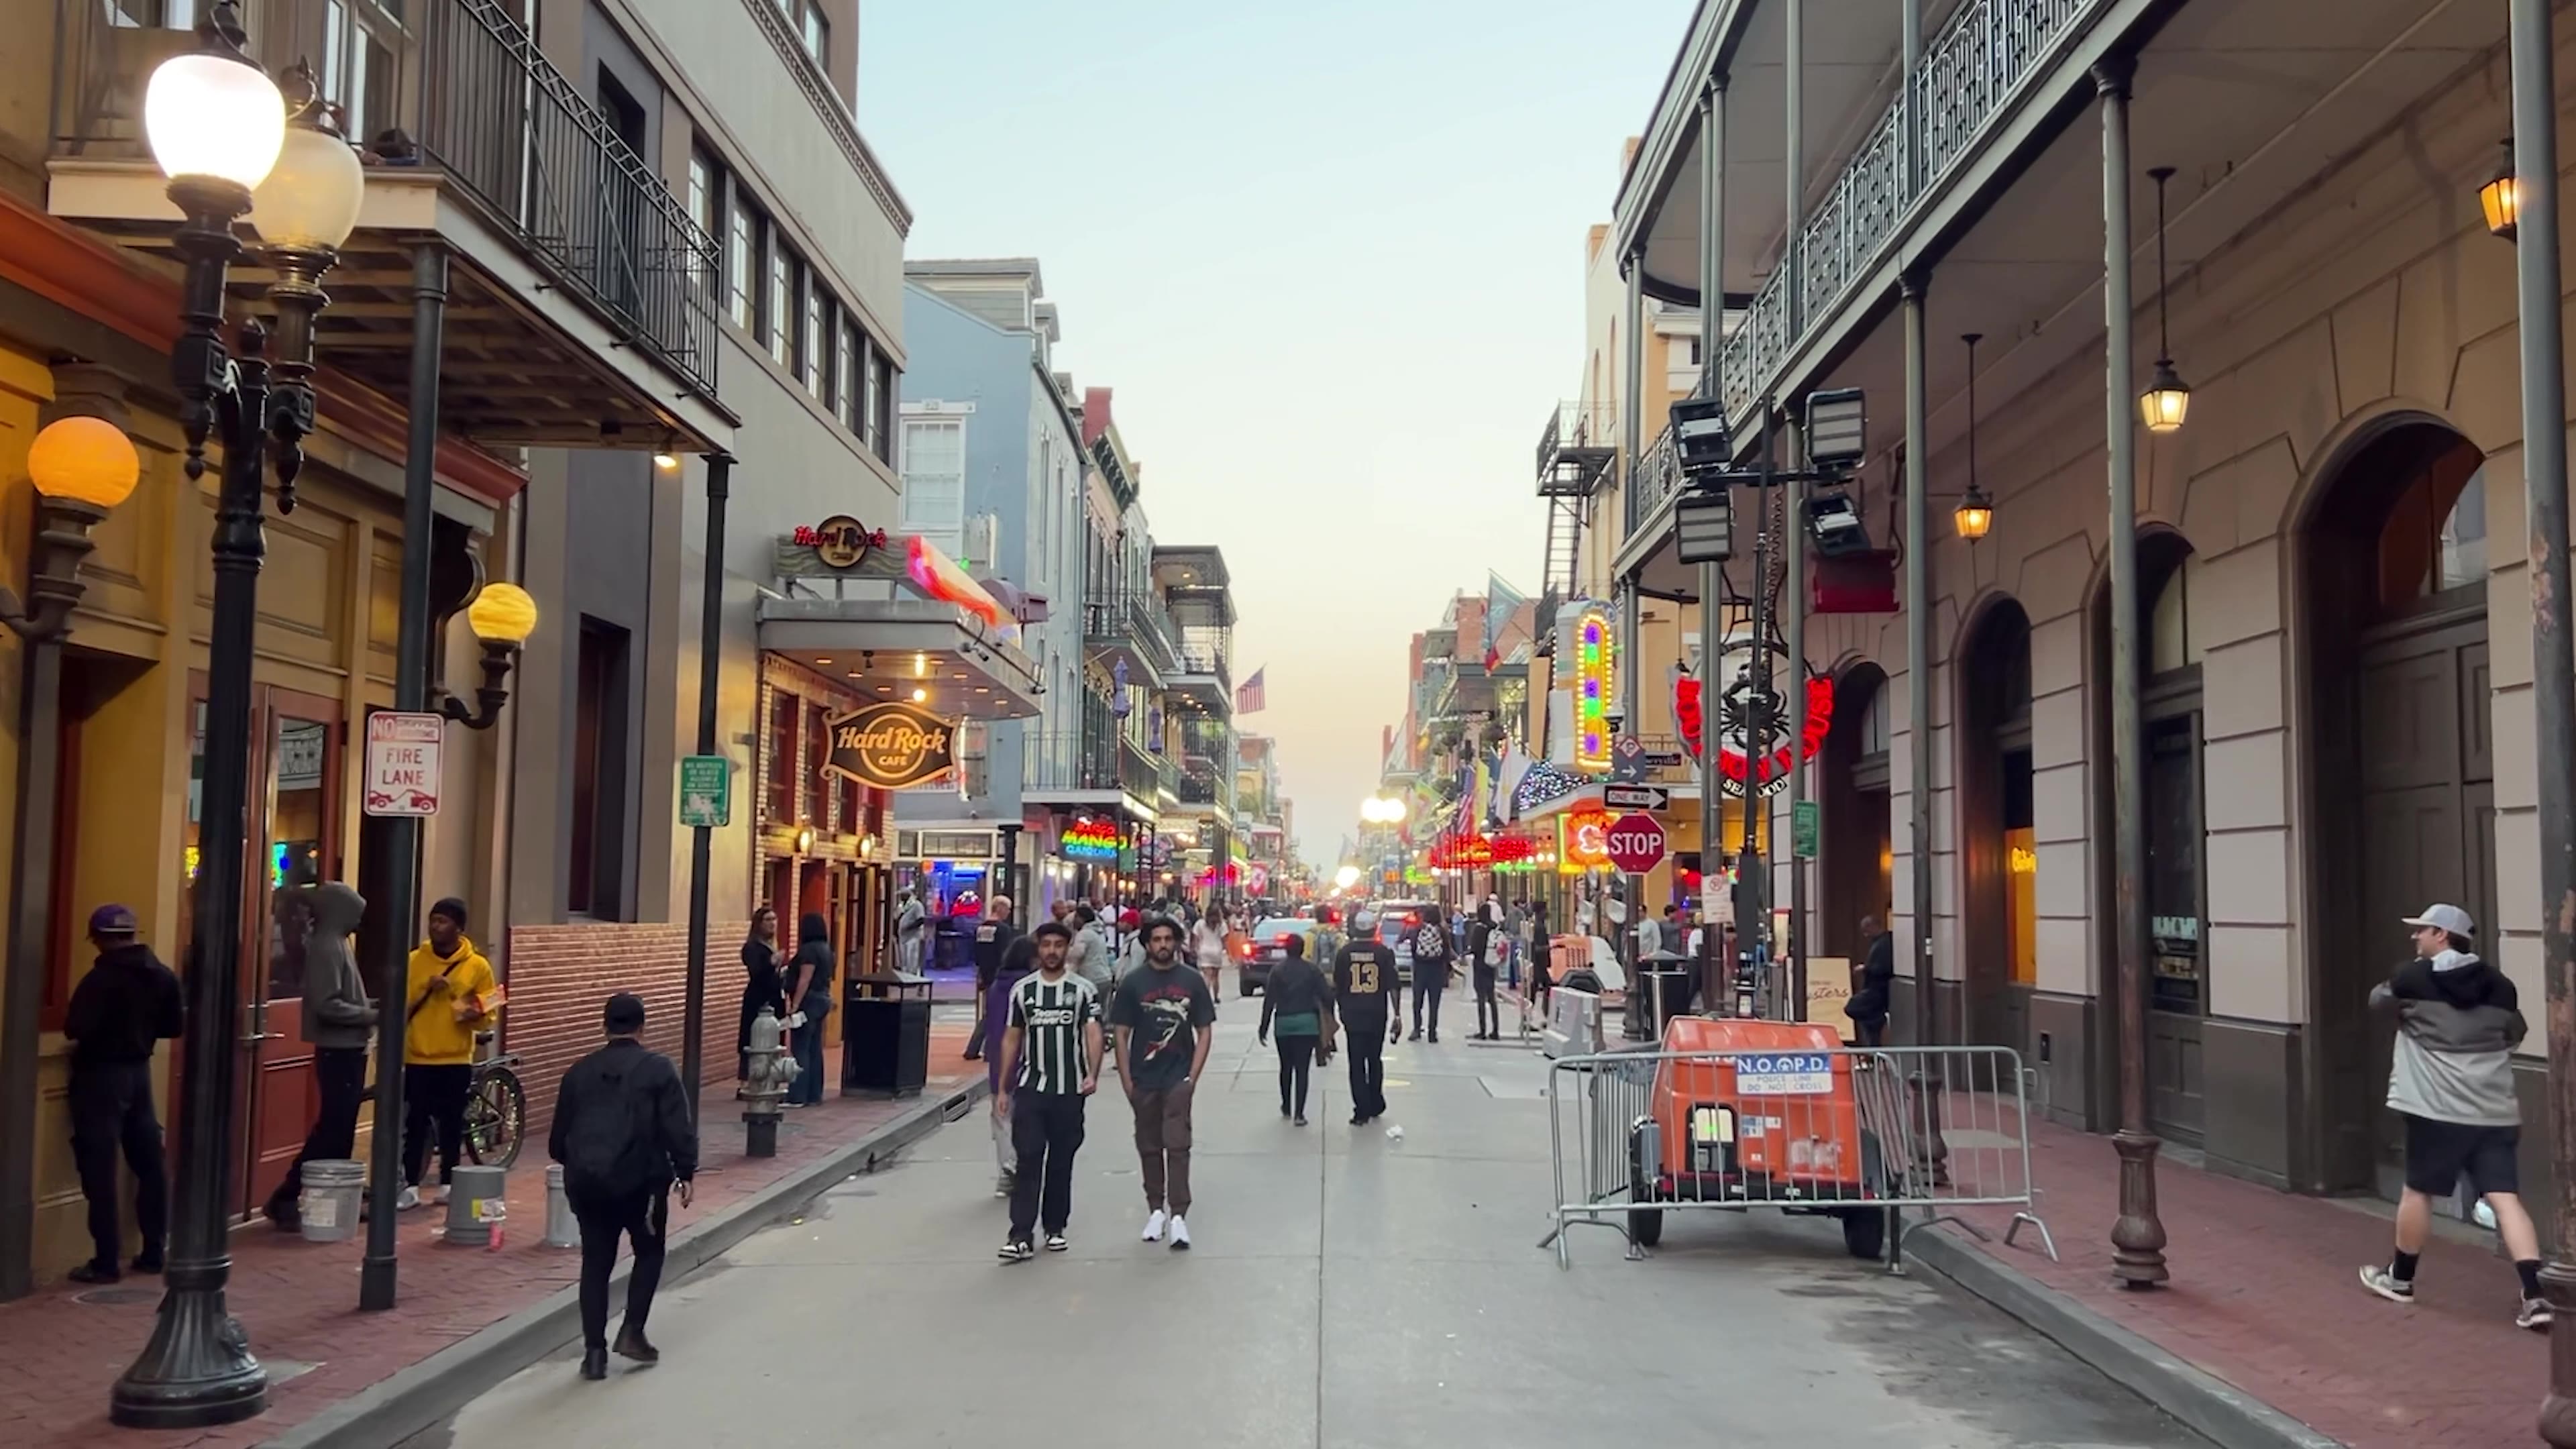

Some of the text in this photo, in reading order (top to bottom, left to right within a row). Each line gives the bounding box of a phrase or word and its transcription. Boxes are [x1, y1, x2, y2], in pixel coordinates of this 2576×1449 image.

[794, 525, 842, 547] Hard
[372, 716, 396, 741] NO
[838, 727, 946, 754] Hard Rock
[386, 748, 423, 764] FIRE
[878, 755, 908, 766] CAFE
[382, 769, 425, 786] LANE
[1611, 792, 1628, 800] ONE
[1610, 833, 1662, 855] STOP
[1350, 963, 1379, 993] 13
[1807, 987, 1849, 1000] sters
[1793, 1082, 1823, 1090] CROSS
